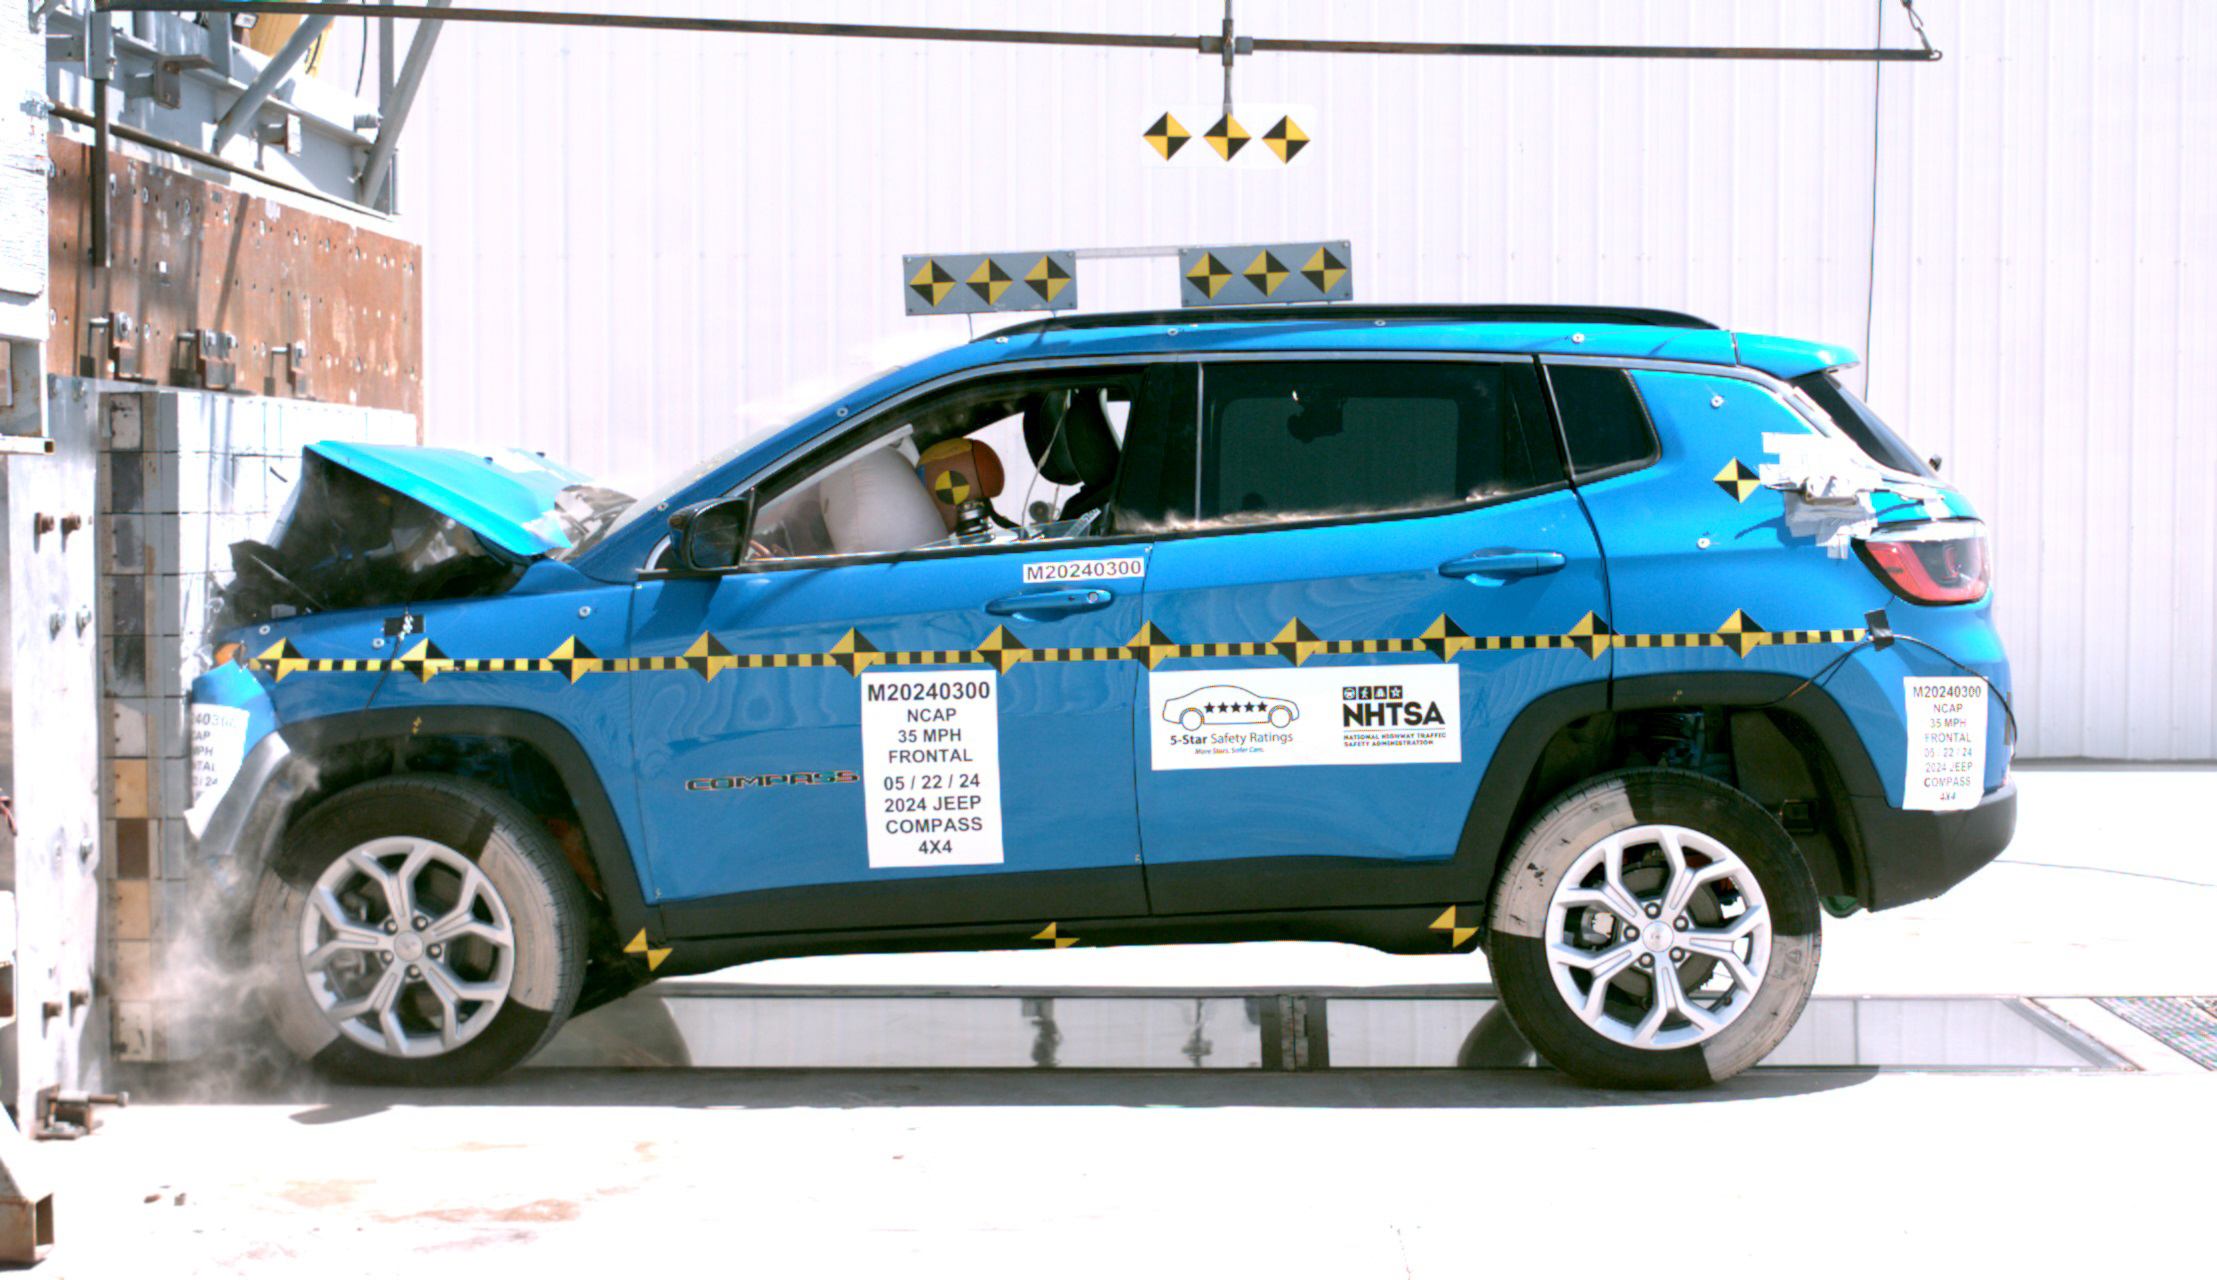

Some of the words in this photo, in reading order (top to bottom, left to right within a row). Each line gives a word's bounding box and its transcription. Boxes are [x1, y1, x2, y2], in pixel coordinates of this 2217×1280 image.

[1027, 560, 1142, 581] M20240300
[868, 681, 990, 701] M20240300
[1913, 684, 1982, 698] M20240300
[907, 708, 956, 722] NCAP
[1342, 701, 1446, 727] NHTSA
[1933, 703, 1963, 714] NCAP
[1930, 718, 1942, 728] 35
[1944, 718, 1966, 728] MPH
[898, 730, 917, 743] 35
[924, 728, 961, 742] MPH
[1170, 734, 1208, 745] 5-Star
[1211, 732, 1247, 746] Safety
[1250, 732, 1293, 744] Ratings
[1925, 732, 1972, 743] FRONTAL
[889, 748, 973, 763] FRONTAL
[1924, 747, 1935, 758] 05
[1943, 746, 1954, 758] 22
[1962, 746, 1972, 758] 24
[1925, 762, 1948, 773] 2024
[1949, 761, 1973, 772] JEEP
[685, 770, 860, 791] COMPASS
[884, 776, 904, 790] 05
[911, 776, 915, 789] /
[922, 774, 942, 789] 22
[949, 775, 953, 788] /
[960, 773, 980, 788] 24
[1923, 776, 1971, 788] COMPASS
[885, 798, 927, 812] 2024
[933, 795, 981, 810] JEEP
[886, 817, 982, 834] COMPASS
[919, 840, 952, 854] 4X4
